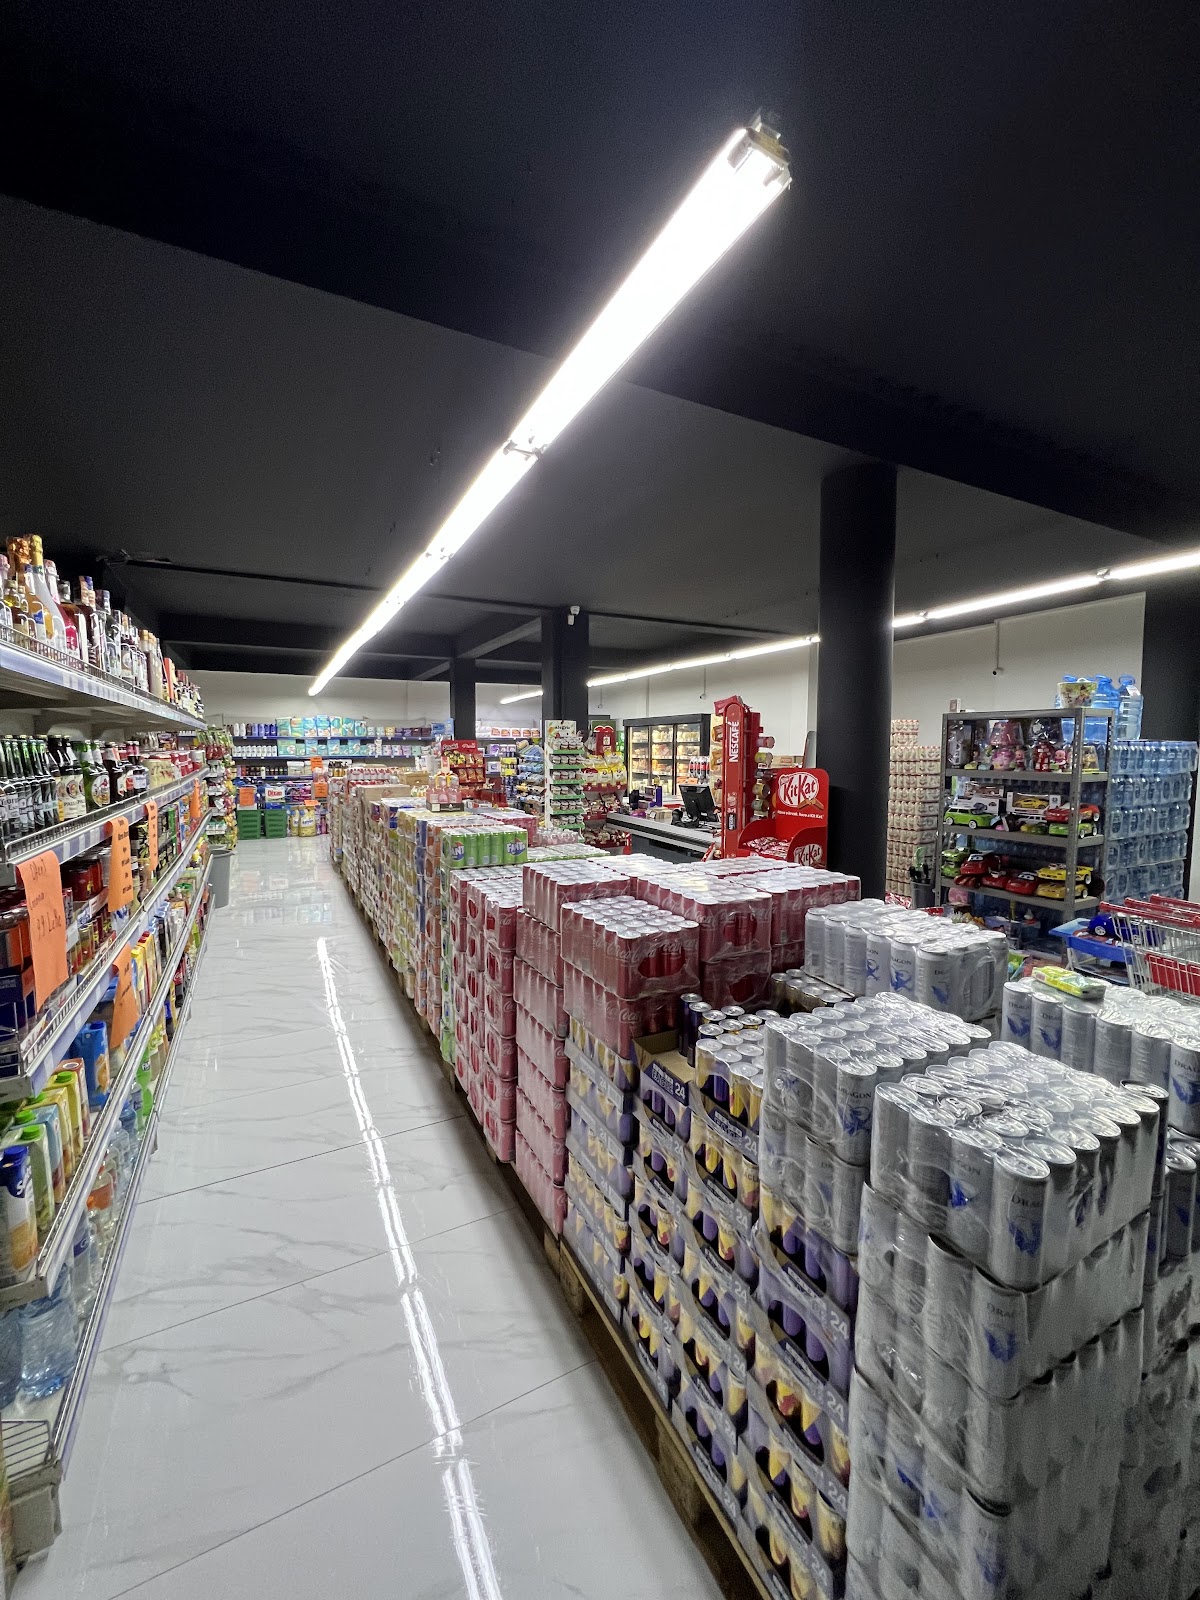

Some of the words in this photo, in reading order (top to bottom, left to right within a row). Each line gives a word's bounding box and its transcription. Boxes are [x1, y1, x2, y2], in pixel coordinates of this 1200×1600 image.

[674, 1082, 686, 1100] 24
[744, 1135, 758, 1156] 24
[736, 1212, 748, 1229] 24
[734, 1281, 747, 1303] 24
[830, 1311, 849, 1340] 24
[826, 1390, 845, 1423] 24
[811, 1553, 828, 1586] 24
